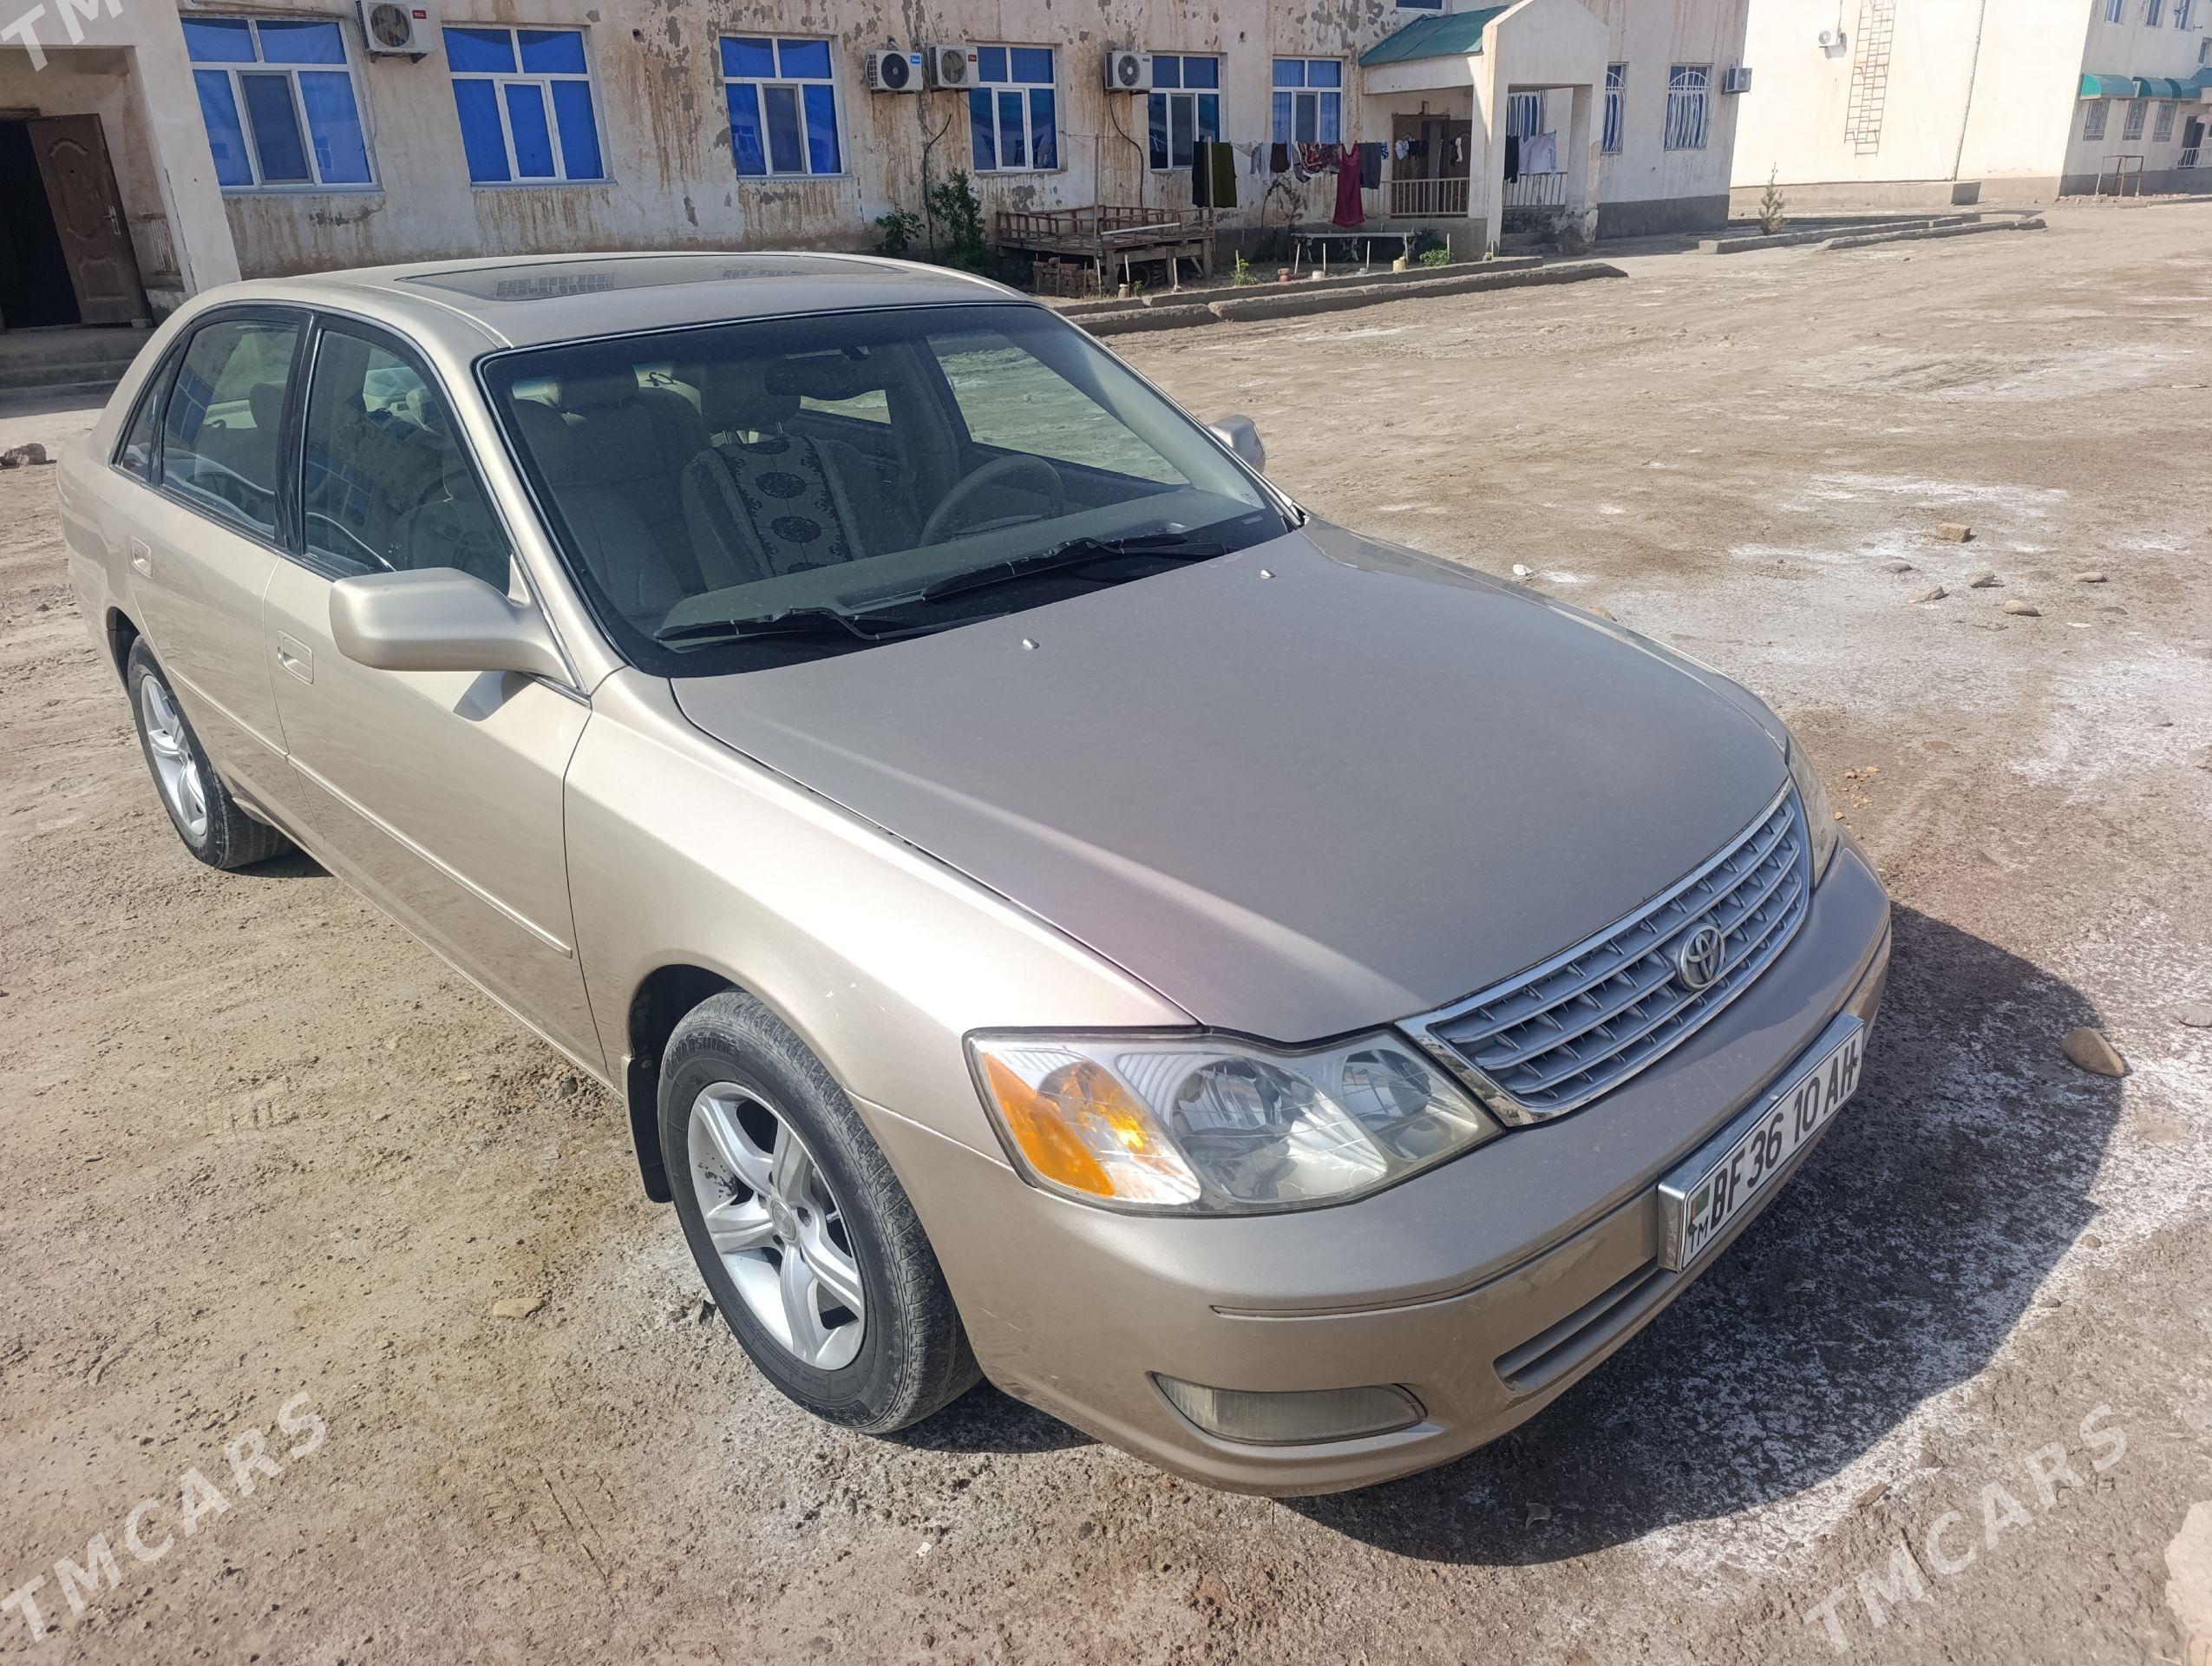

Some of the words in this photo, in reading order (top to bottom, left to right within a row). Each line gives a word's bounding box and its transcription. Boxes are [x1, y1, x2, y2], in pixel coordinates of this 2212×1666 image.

[1711, 1148, 1745, 1230] BF
[1747, 1112, 1783, 1188] 36
[1793, 1077, 1821, 1144] 10
[1823, 1040, 1856, 1115] AH
